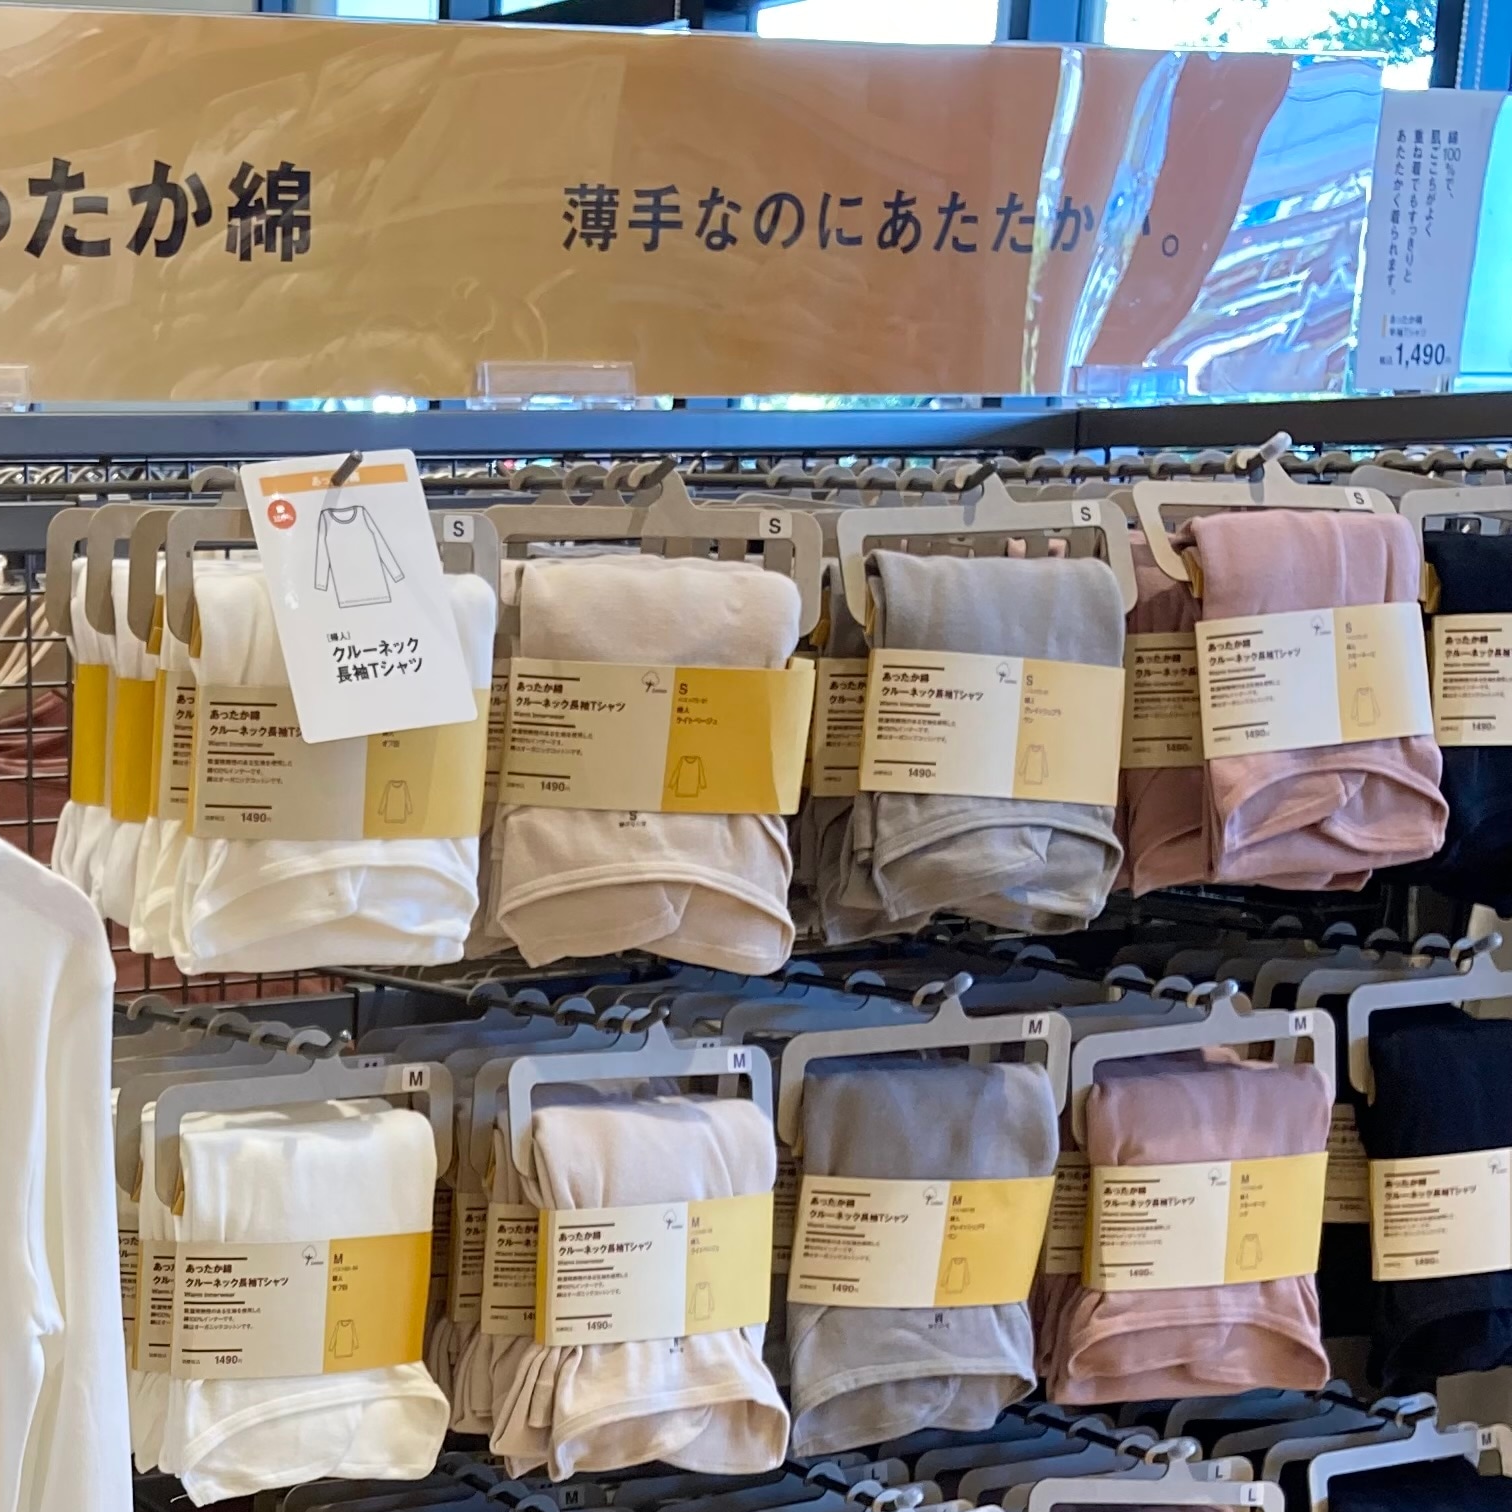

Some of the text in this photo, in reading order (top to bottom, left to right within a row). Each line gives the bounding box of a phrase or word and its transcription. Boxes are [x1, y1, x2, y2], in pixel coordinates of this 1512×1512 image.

[562, 182, 1181, 258] 薄手なのにあたたか。
[1354, 493, 1364, 504] S
[1080, 506, 1091, 521] S
[453, 521, 464, 537] S
[769, 518, 781, 534] S
[332, 636, 420, 663] クルーネック
[336, 656, 424, 684] 長袖Tシャツ
[1026, 675, 1033, 685] S
[517, 682, 563, 694] あったか綿
[679, 683, 688, 695] S
[209, 710, 260, 721] あったか綿
[1029, 1020, 1042, 1034] M
[1295, 1017, 1307, 1030] M
[733, 1053, 745, 1068] M
[409, 1072, 423, 1086] M
[691, 1217, 700, 1227] M
[333, 1253, 343, 1265] M
[186, 1263, 232, 1274] あったか綿
[185, 1277, 289, 1288] クルーネック長袖Tシャツ
[1481, 1432, 1492, 1446] M
[871, 1468, 879, 1480] L
[1215, 1466, 1223, 1478] L
[1249, 1488, 1257, 1501] L
